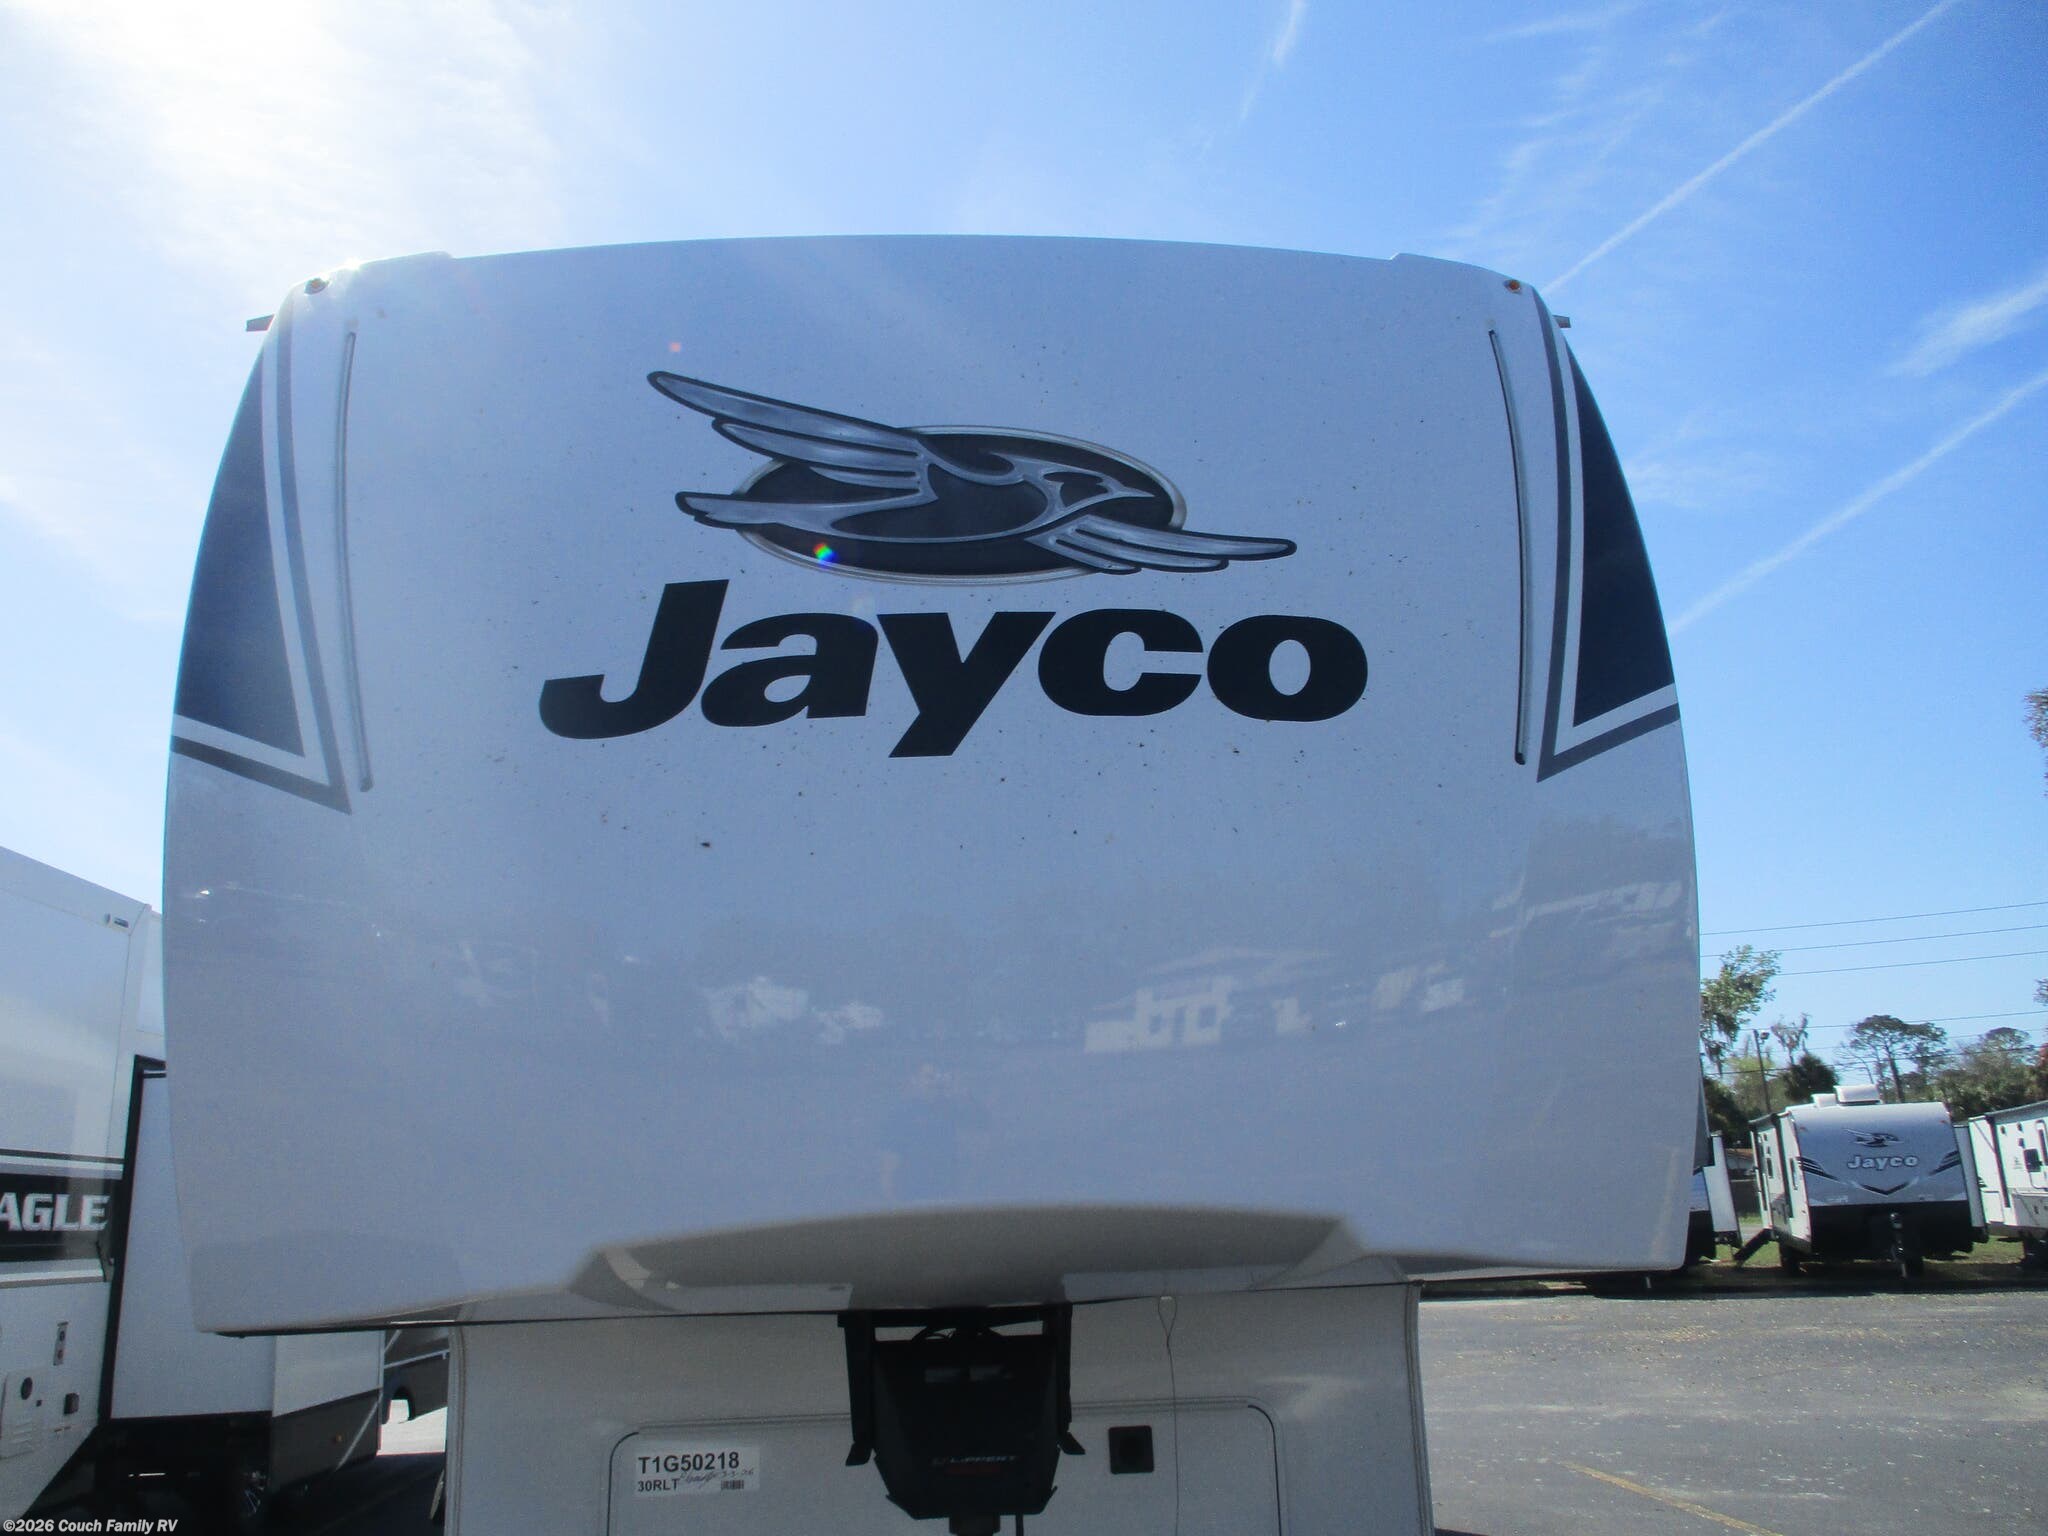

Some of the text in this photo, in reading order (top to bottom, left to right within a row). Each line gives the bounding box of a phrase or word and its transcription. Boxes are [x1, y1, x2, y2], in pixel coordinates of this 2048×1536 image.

[538, 579, 1369, 758] Jayco
[1847, 1154, 1920, 1171] Jayco
[0, 1192, 111, 1231] AGLE
[638, 1451, 740, 1474] T1G50218
[638, 1478, 680, 1492] 30RLT
